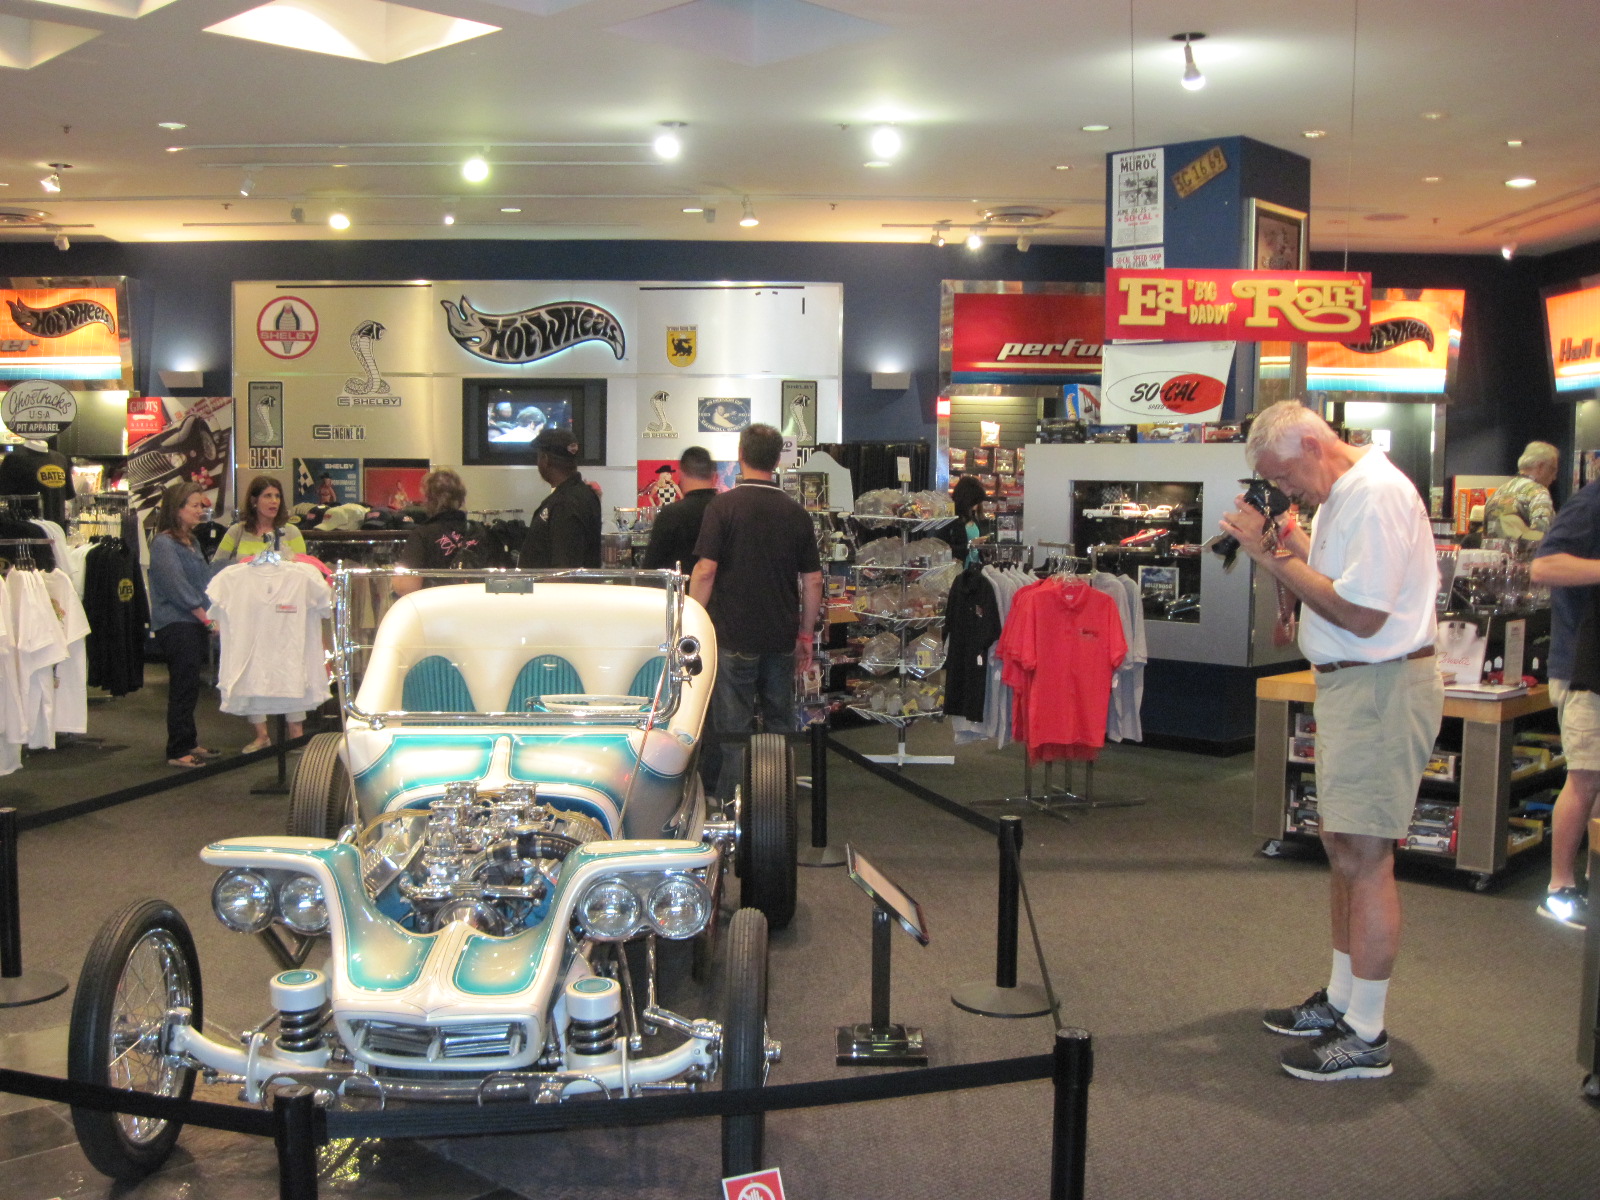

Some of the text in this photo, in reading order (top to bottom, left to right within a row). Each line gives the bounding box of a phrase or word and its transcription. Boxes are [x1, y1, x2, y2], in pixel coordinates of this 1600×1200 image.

[1120, 158, 1157, 172] MUROC
[260, 331, 315, 340] SHELBY
[996, 339, 1103, 361] perfo
[1130, 382, 1200, 403] SO-CAL
[16, 423, 60, 431] PIT APPAREL
[332, 427, 353, 440] ENGINE
[40, 471, 66, 481] BATES
